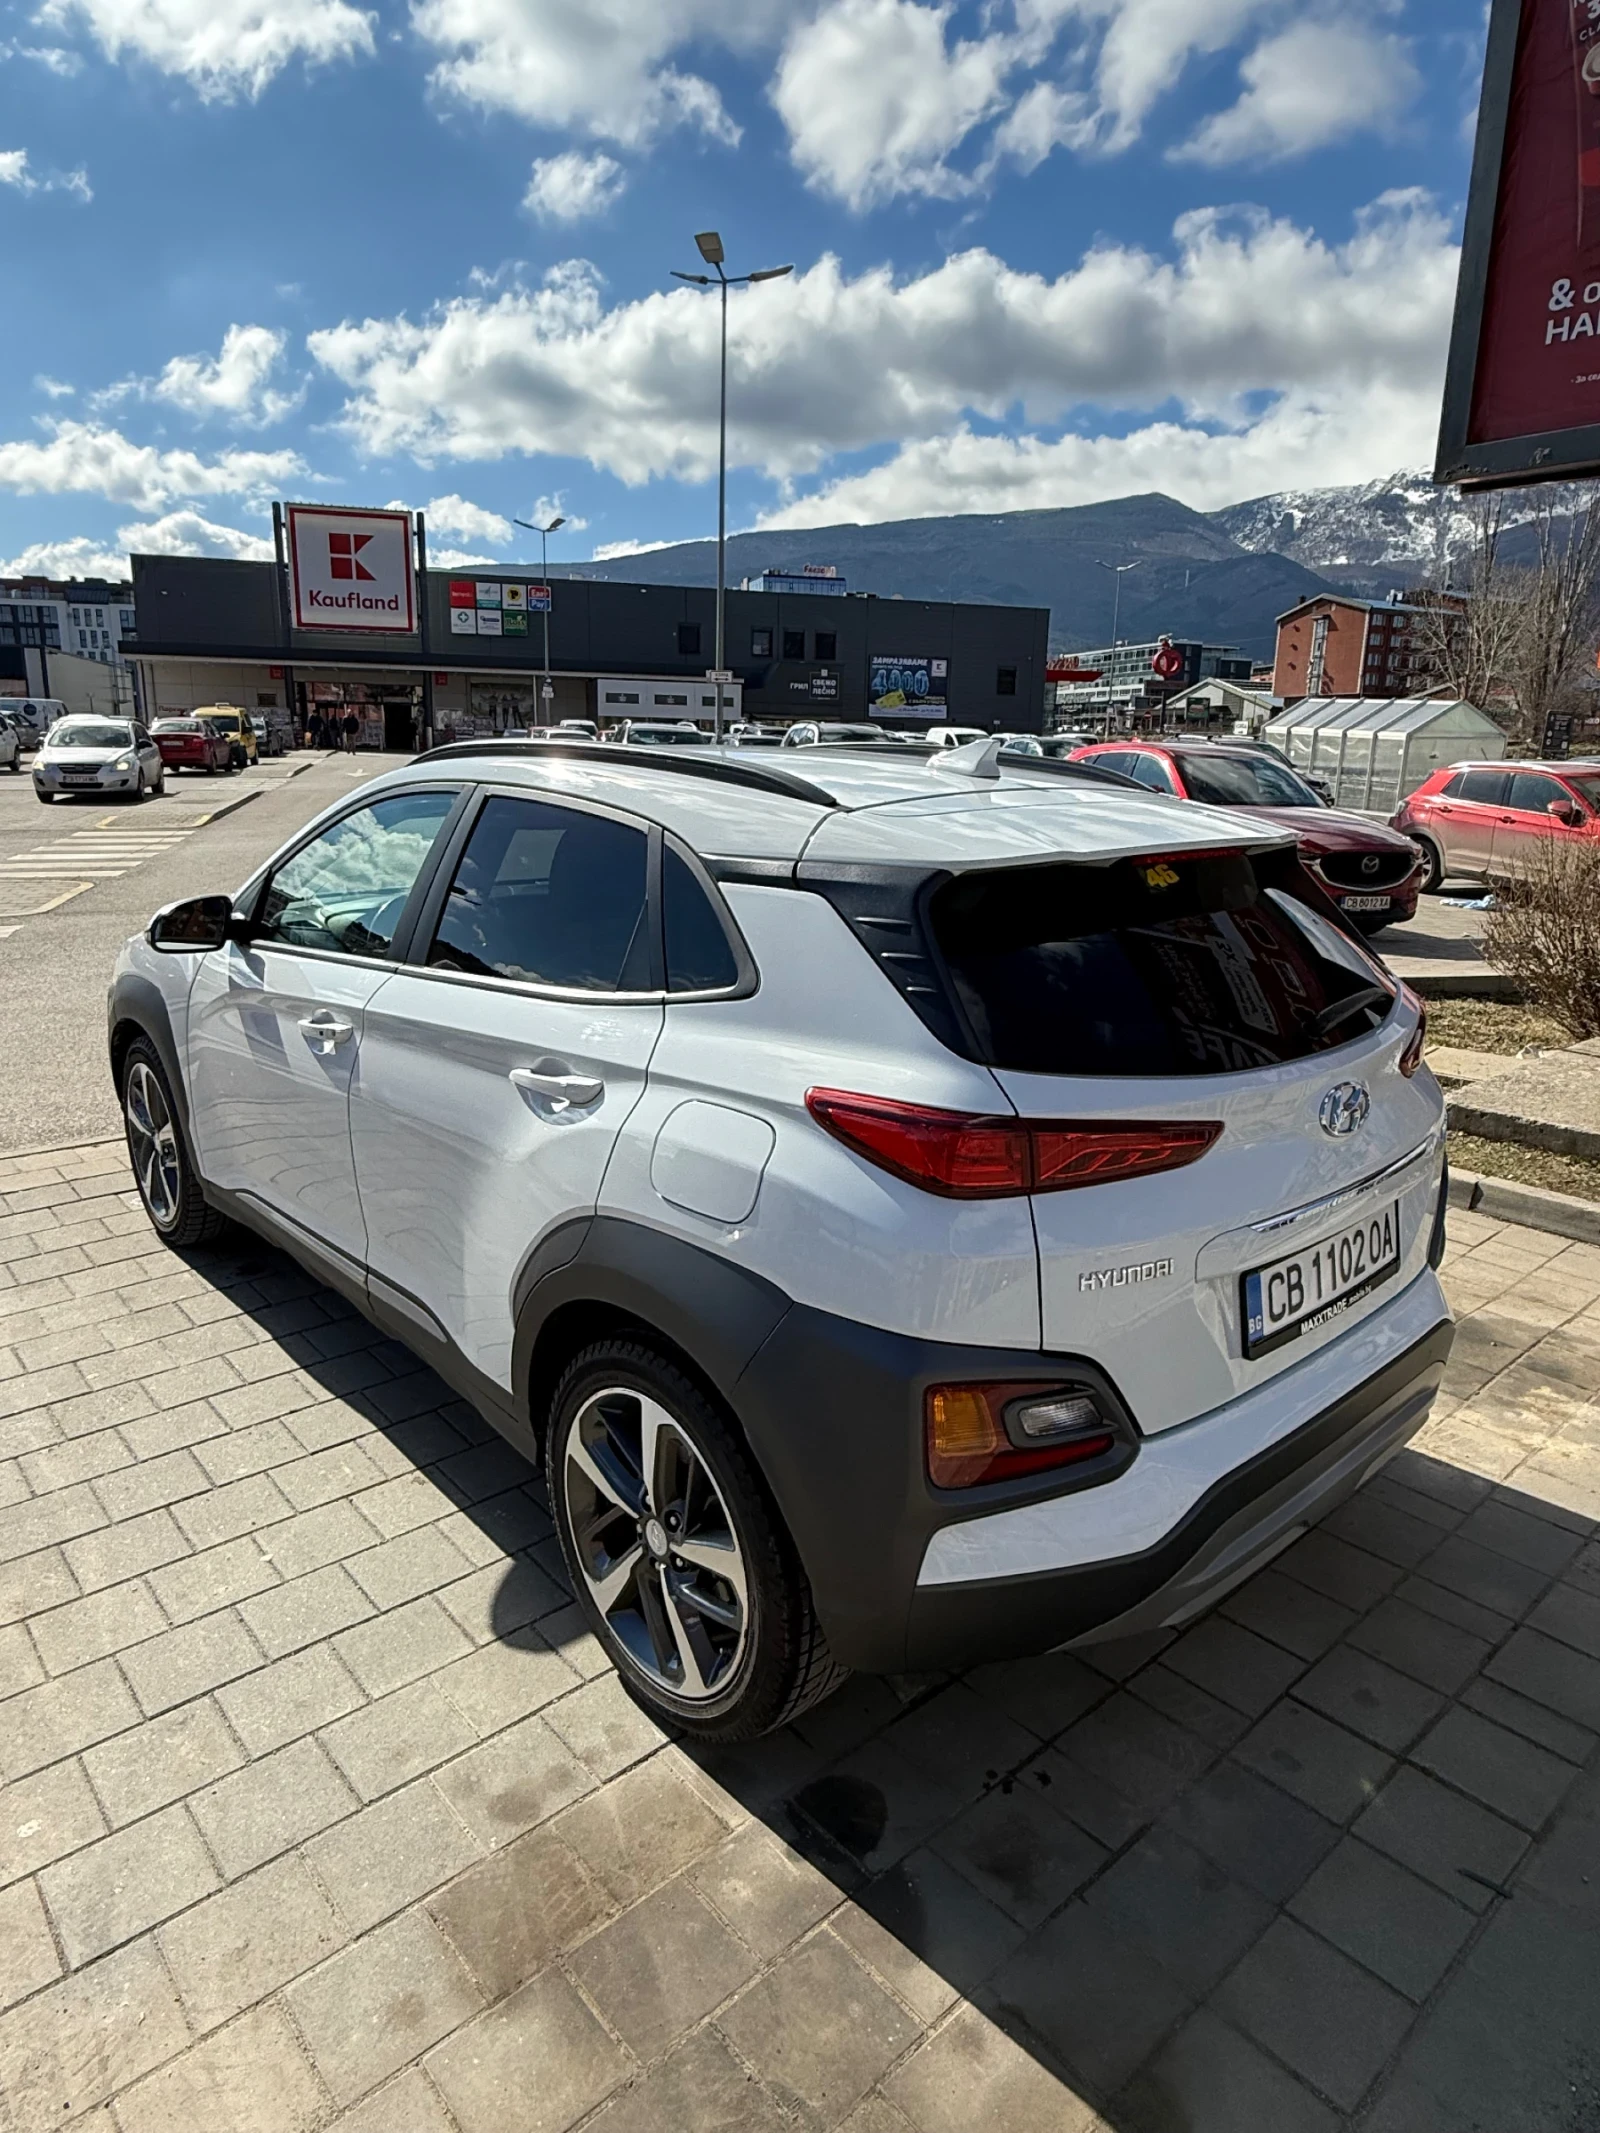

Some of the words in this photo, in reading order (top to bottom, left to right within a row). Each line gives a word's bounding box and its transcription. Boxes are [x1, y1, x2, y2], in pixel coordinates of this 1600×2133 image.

[1548, 278, 1576, 312] &
[308, 589, 400, 611] Kaufland
[531, 599, 545, 610] Pay
[790, 682, 809, 690] ГРИЛ
[812, 678, 837, 687] СВЕЖО
[812, 687, 836, 695] ЛЕСНО
[871, 669, 930, 696] 4000
[1146, 864, 1180, 887] 46
[1346, 897, 1358, 908] CB
[1358, 897, 1379, 908] 8012
[1379, 897, 1389, 907] XA
[1079, 1258, 1174, 1292] HYUNDAI
[1268, 1263, 1305, 1323] CB
[1312, 1229, 1366, 1301] 1102
[1369, 1212, 1394, 1265] OA
[1248, 1315, 1263, 1334] BG
[1300, 1298, 1349, 1335] MAXXTRADE
